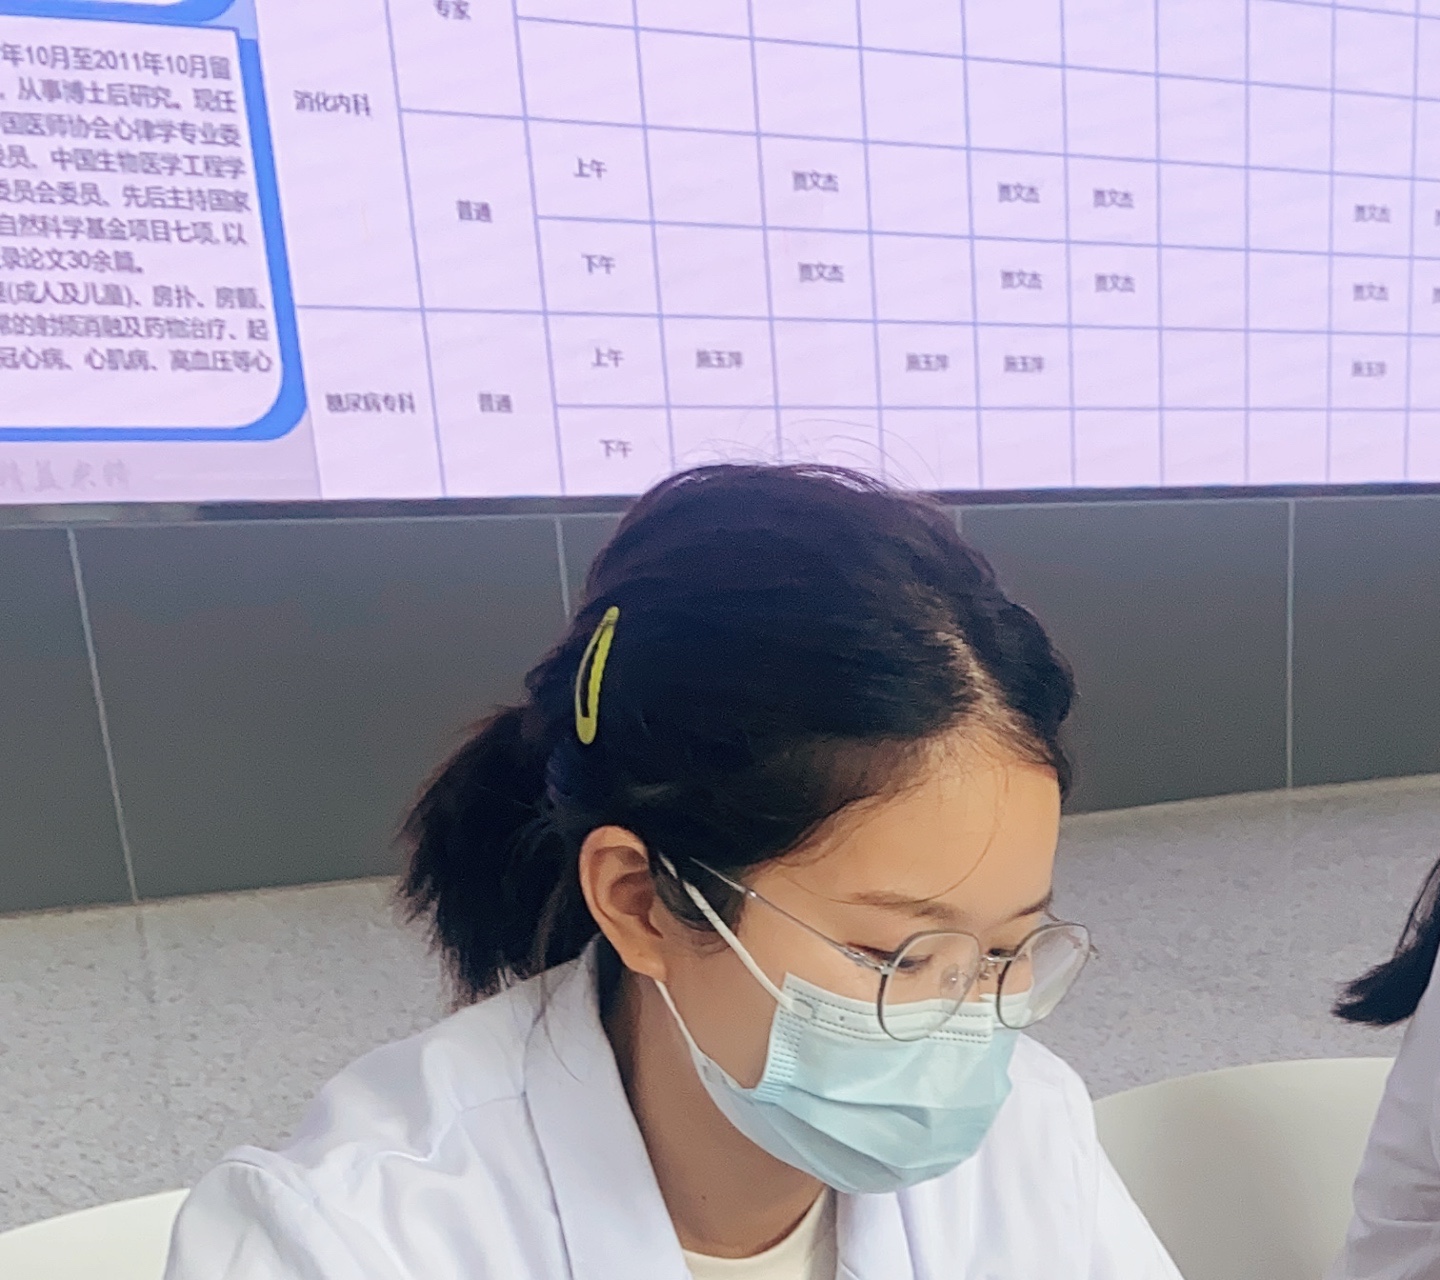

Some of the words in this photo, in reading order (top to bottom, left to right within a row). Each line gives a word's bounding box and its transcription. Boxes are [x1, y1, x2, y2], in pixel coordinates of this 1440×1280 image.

[295, 90, 372, 118] 消化内科
[575, 159, 608, 180] 上午
[582, 255, 617, 276] 下午
[593, 348, 624, 369] 上午
[600, 440, 633, 459] 下午
